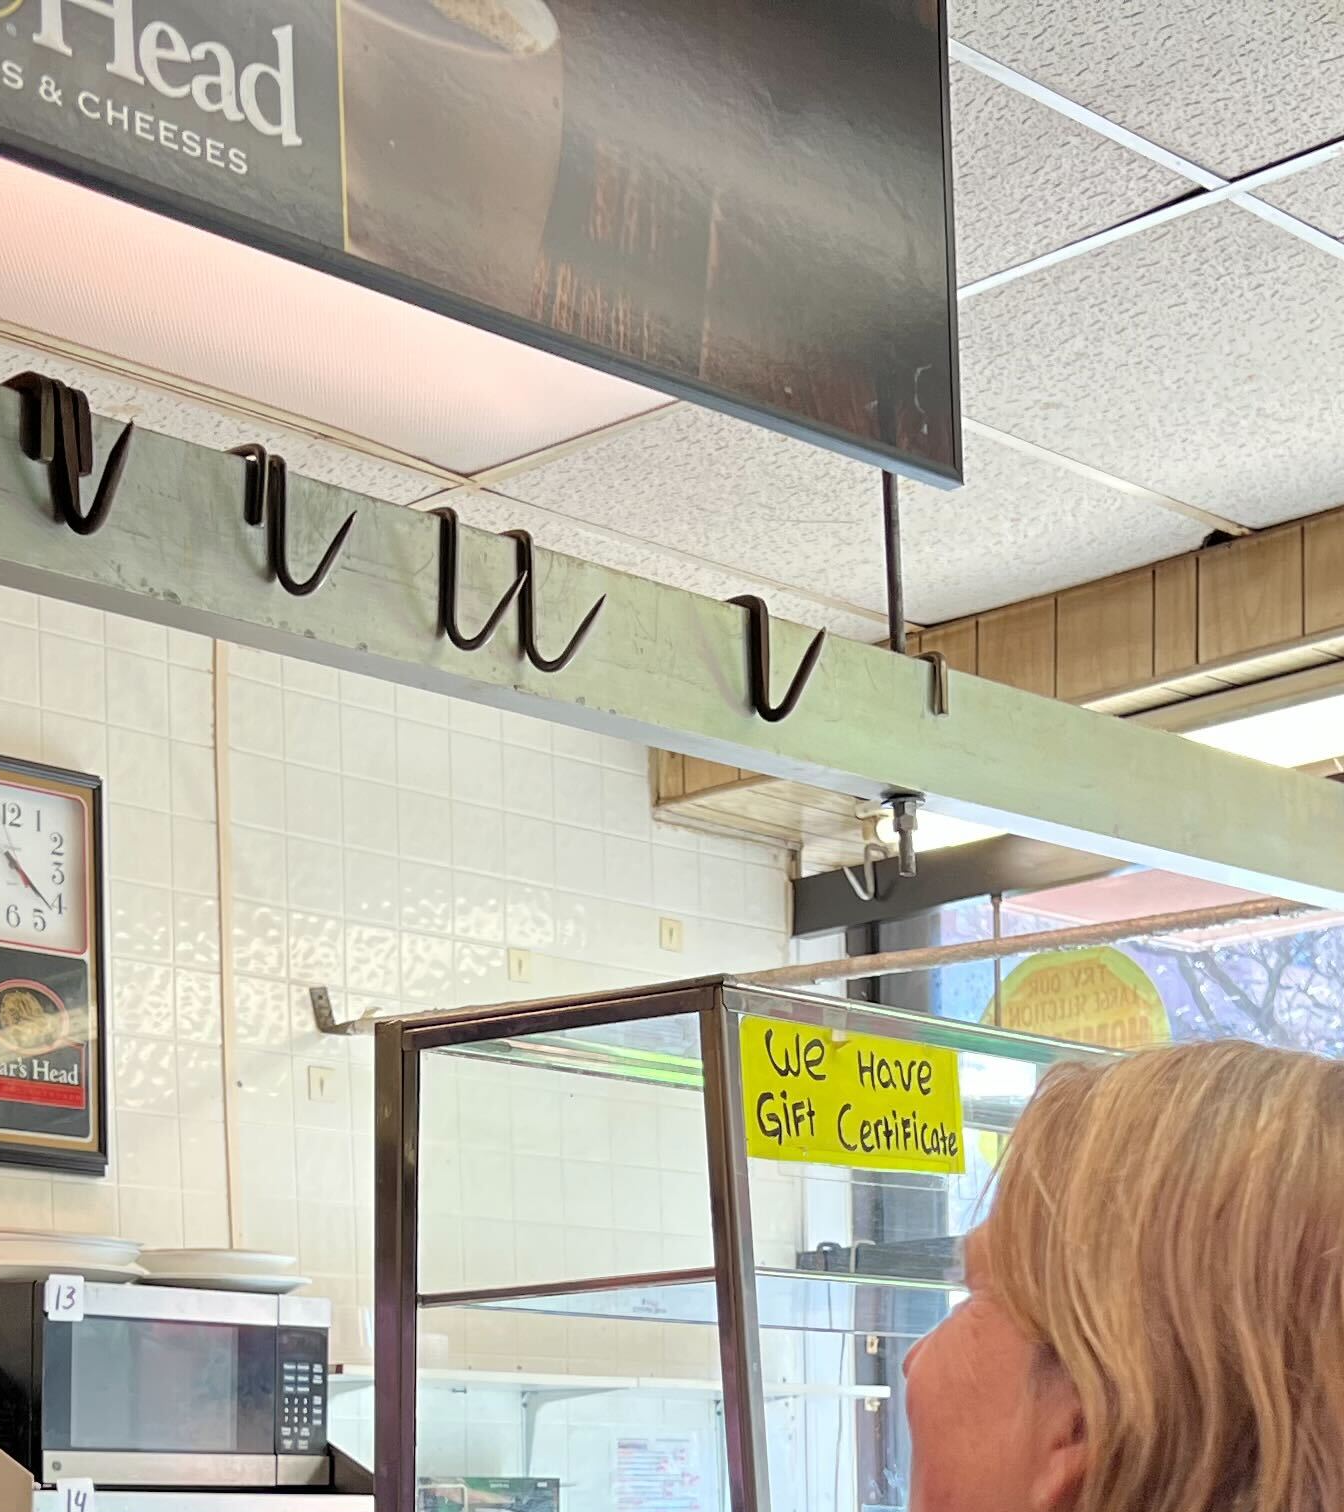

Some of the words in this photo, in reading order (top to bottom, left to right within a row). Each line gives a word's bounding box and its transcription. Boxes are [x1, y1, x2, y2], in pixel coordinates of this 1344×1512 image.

[32, 0, 303, 146] Head
[38, 74, 63, 107] &
[77, 90, 249, 175] CHEESES
[1, 802, 23, 828] 12
[50, 832, 65, 857] 2
[51, 861, 65, 886] 3
[6, 903, 21, 929] 6
[32, 908, 46, 933] 5
[31, 1058, 80, 1086] Head
[764, 1028, 827, 1081] We
[857, 1049, 933, 1096] Have
[55, 1284, 77, 1311] 13
